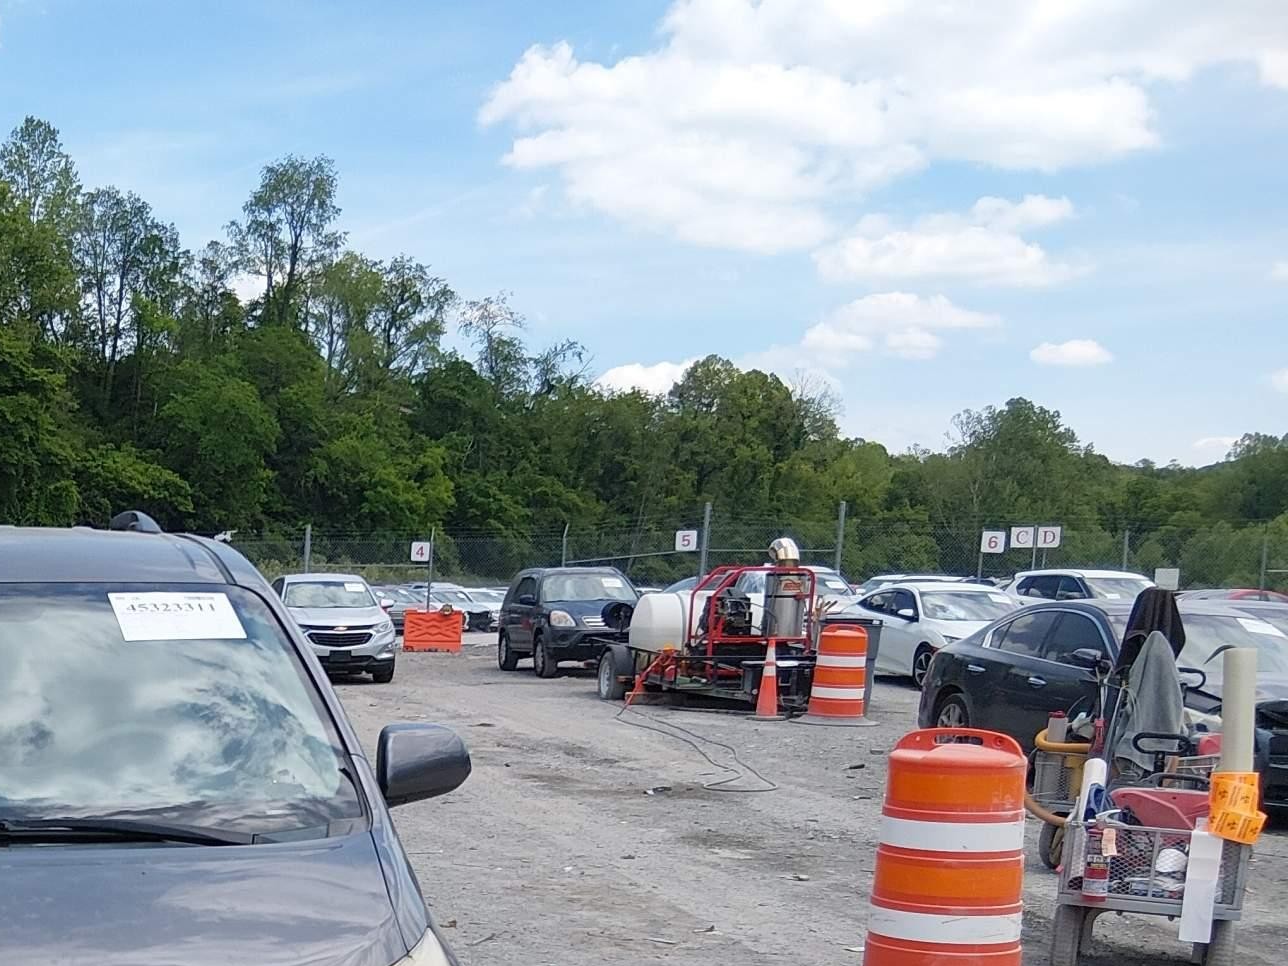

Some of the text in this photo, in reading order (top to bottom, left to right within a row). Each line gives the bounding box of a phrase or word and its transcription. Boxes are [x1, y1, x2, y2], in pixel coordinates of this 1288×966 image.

[682, 534, 690, 547] 5
[988, 536, 998, 549] 6
[1016, 530, 1028, 544] C
[1043, 530, 1056, 544] D
[415, 545, 425, 558] 4
[127, 603, 216, 612] 45323311
